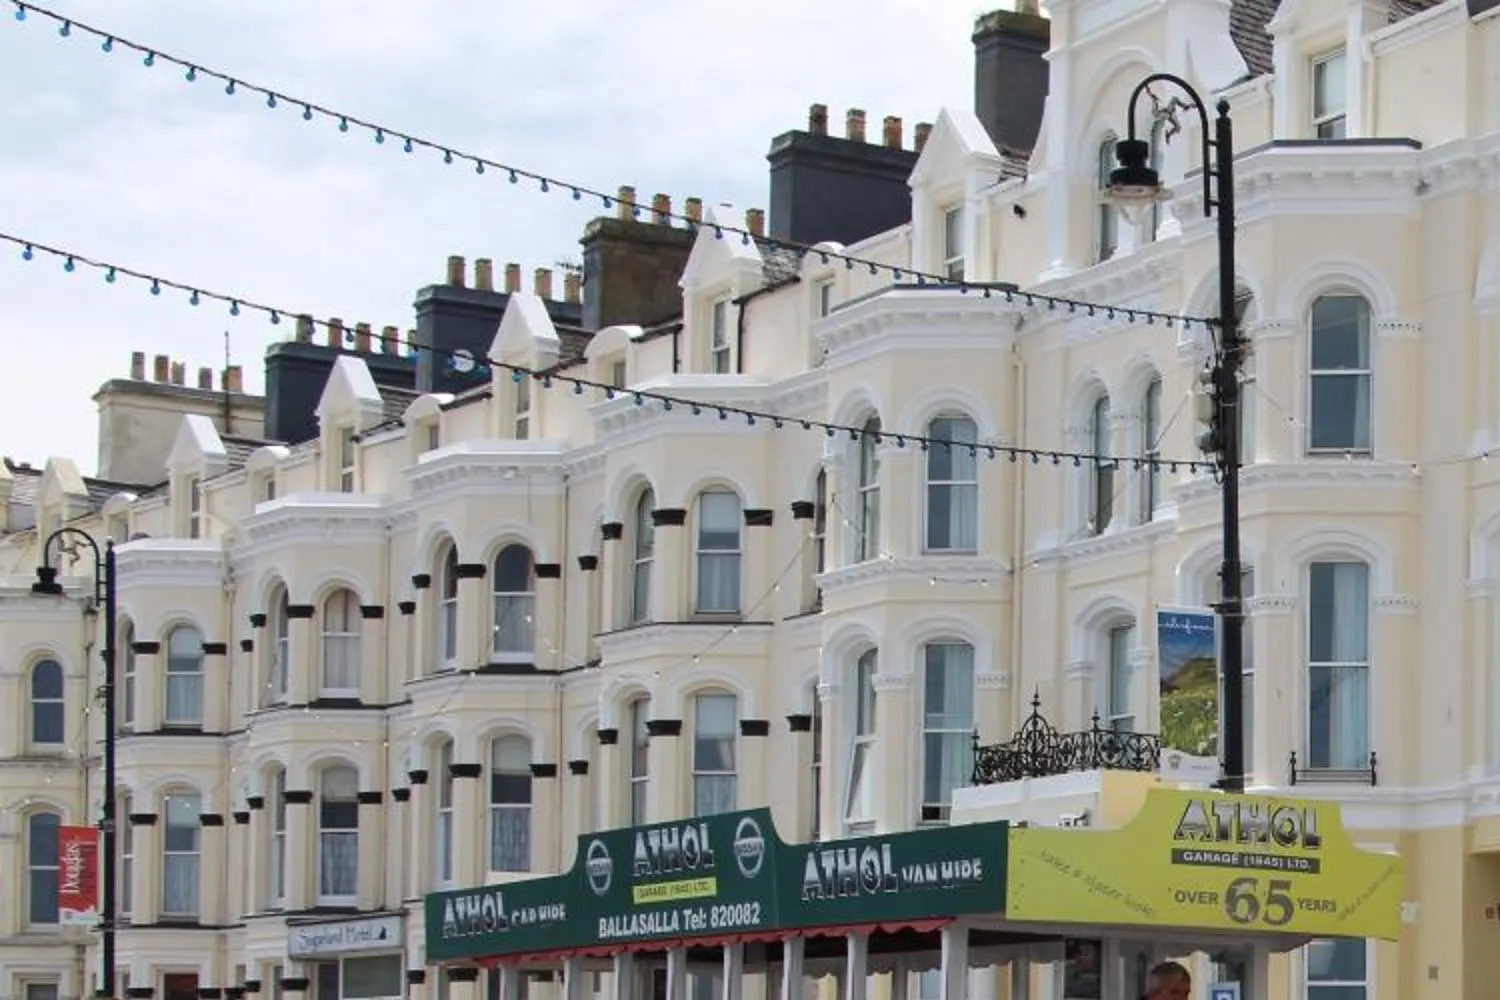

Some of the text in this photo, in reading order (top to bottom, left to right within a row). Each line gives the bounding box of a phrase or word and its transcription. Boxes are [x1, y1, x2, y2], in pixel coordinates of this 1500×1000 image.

[1173, 799, 1322, 849] ATHOL
[632, 823, 716, 877] ATHOL
[801, 844, 899, 901] ATHOL
[902, 863, 938, 884] VAN
[1183, 850, 1239, 865] GARAGE
[441, 891, 510, 939] ATHOL
[598, 901, 761, 939] BALLASALLA Tel: 820082
[1174, 877, 1337, 926] OVER 65 YEARS
